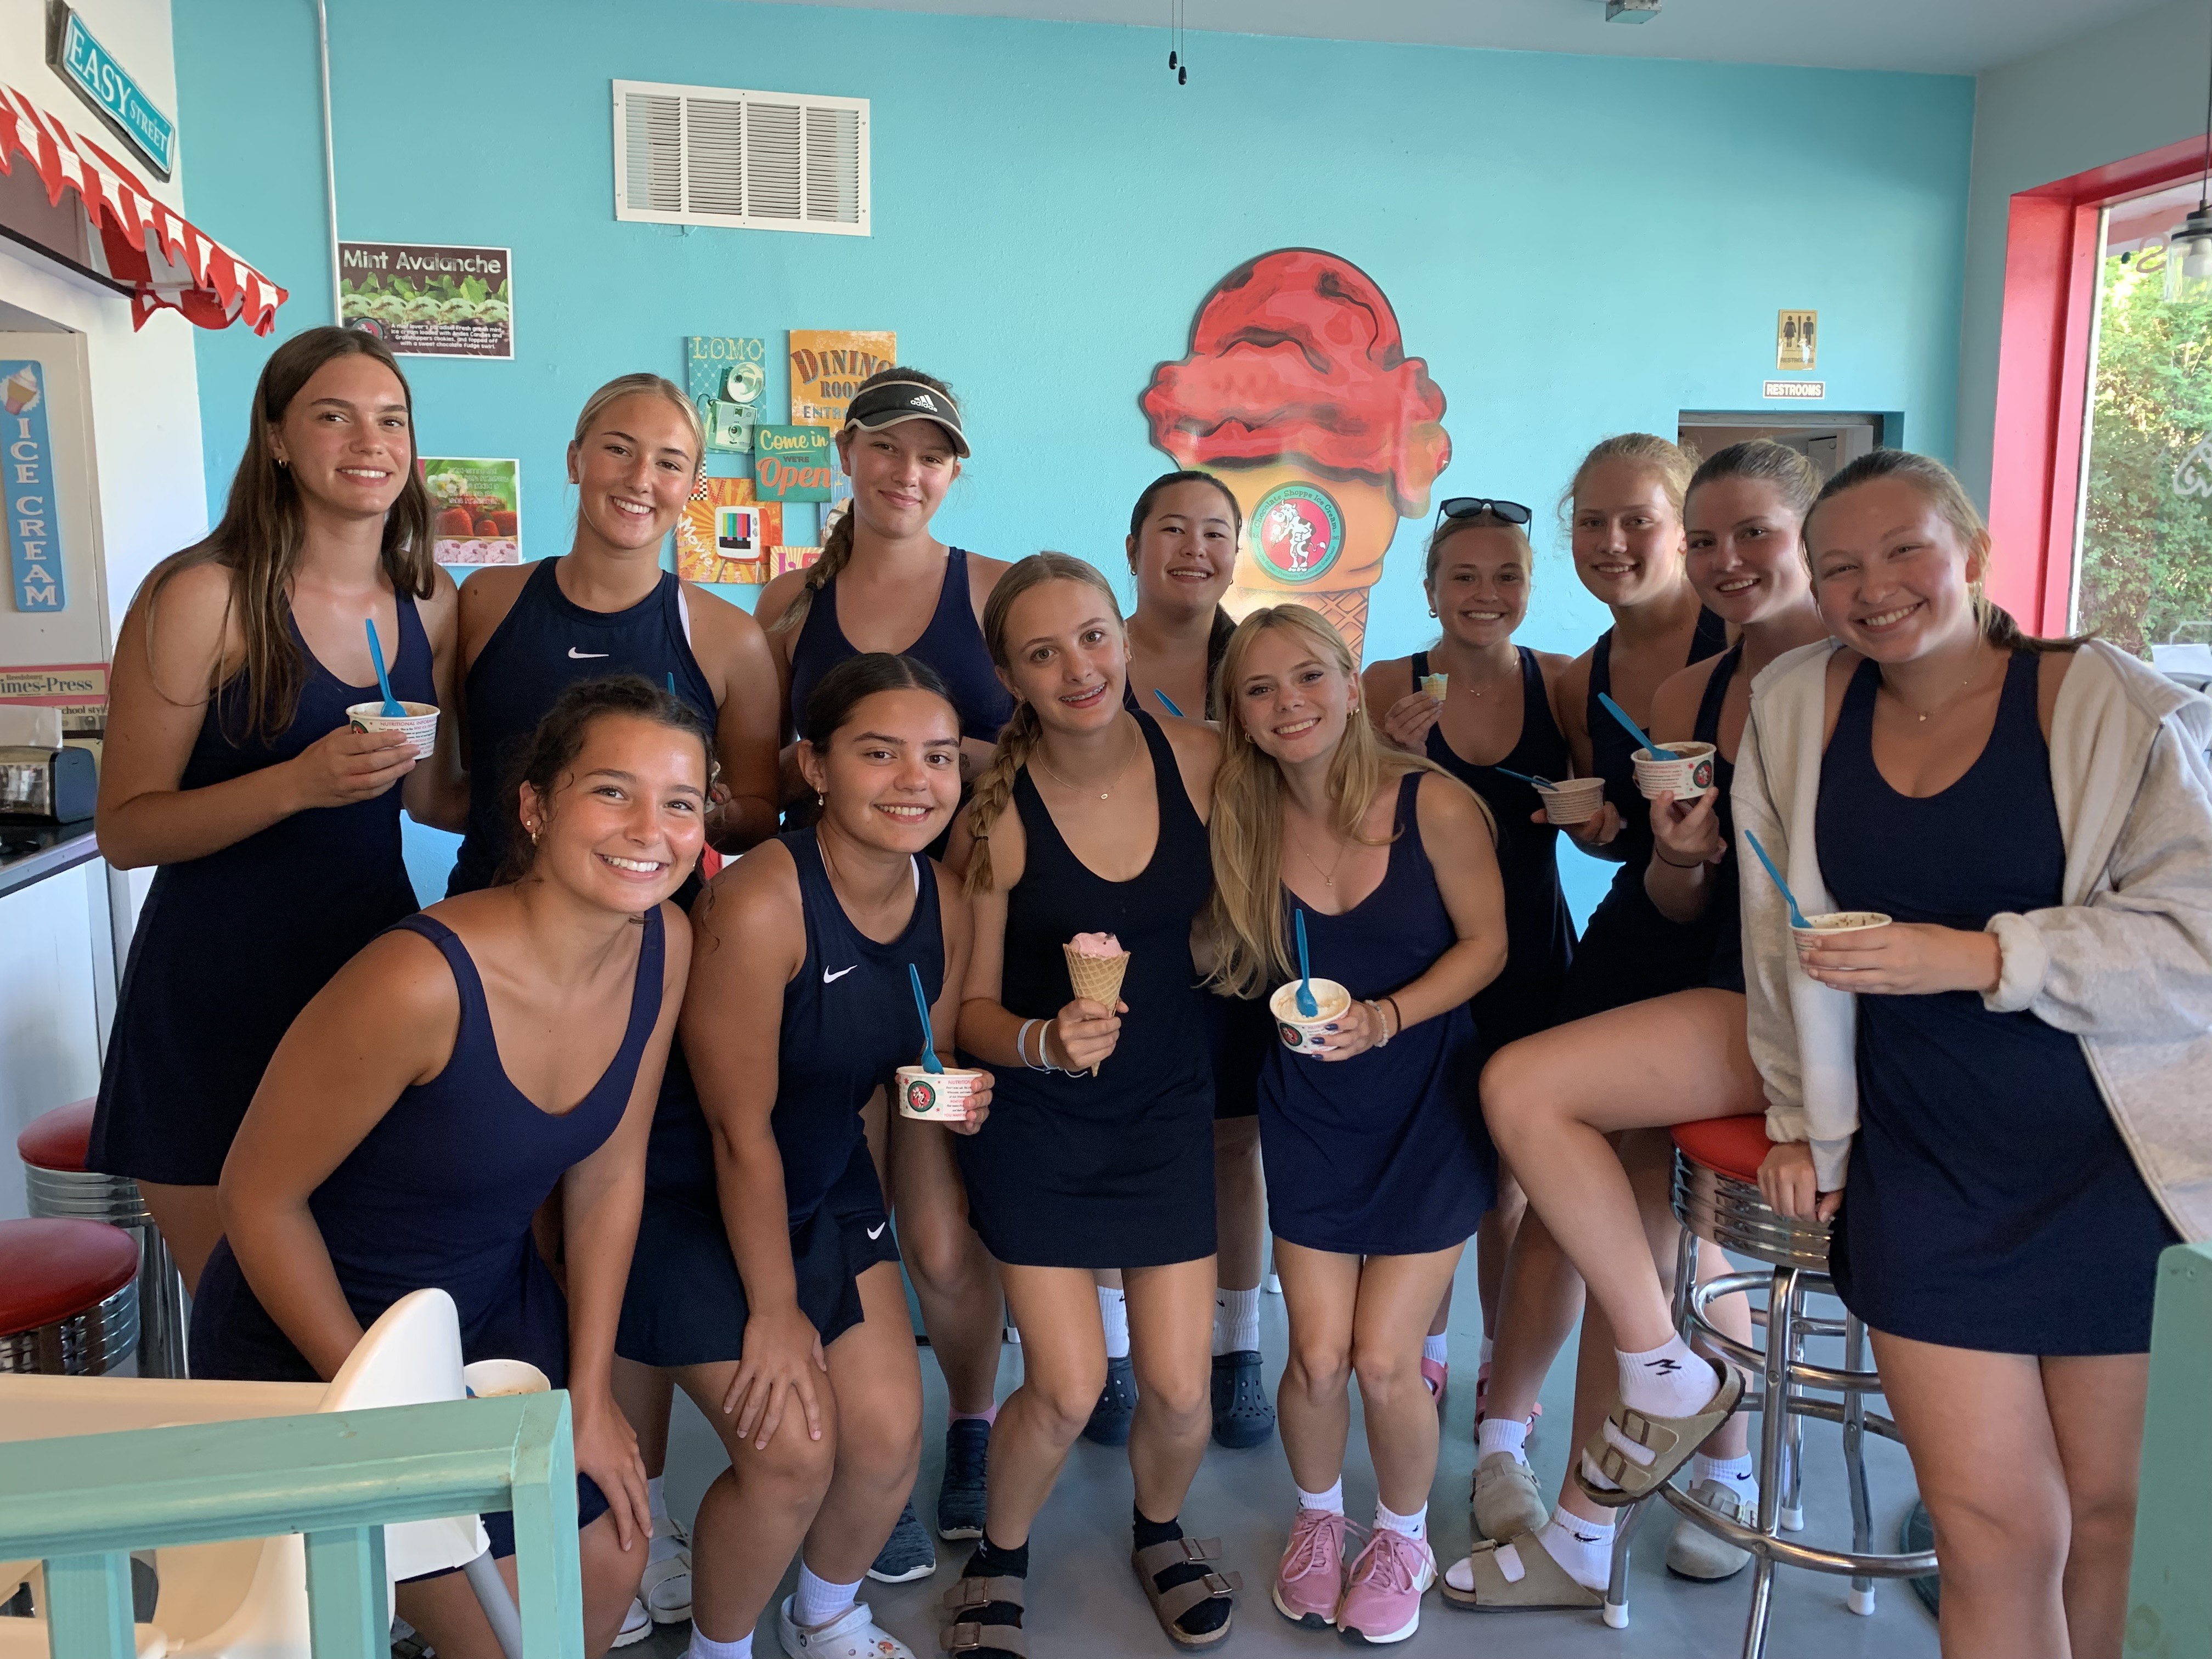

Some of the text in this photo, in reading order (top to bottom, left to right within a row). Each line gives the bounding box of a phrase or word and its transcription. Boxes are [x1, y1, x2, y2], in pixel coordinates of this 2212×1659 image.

[69, 25, 167, 152] EASY STREET
[343, 250, 501, 273] Mint Avalanche
[693, 337, 762, 360] LOMO
[1767, 383, 1821, 396] RESTROOMS
[910, 399, 938, 412] adidas
[760, 430, 828, 450] Come in
[756, 456, 831, 496] Open
[10, 418, 57, 606] ICE CREAM
[1254, 495, 1282, 527] Chocolate
[1284, 489, 1312, 498] Shoppe
[1314, 495, 1324, 505] Ice
[0, 677, 93, 693] imes-Press
[61, 706, 85, 714] chool
